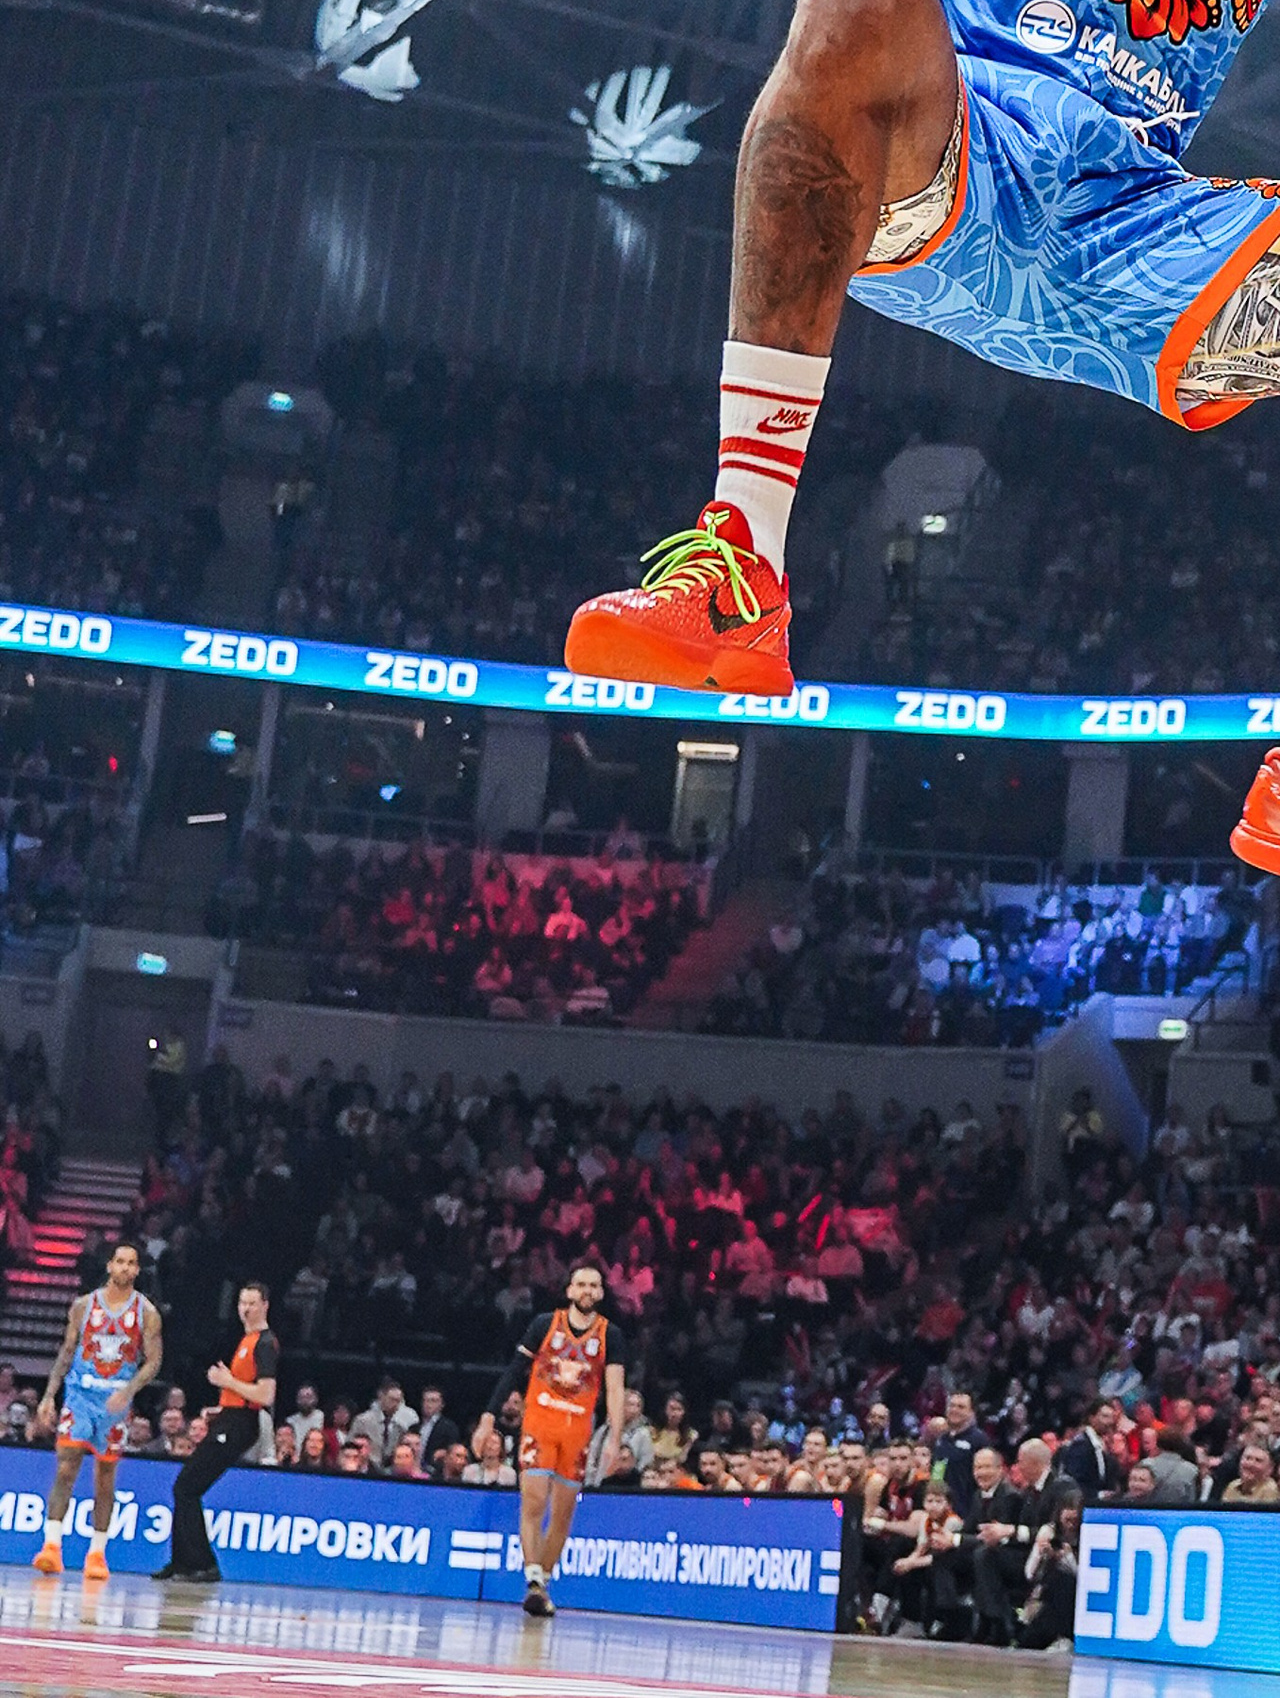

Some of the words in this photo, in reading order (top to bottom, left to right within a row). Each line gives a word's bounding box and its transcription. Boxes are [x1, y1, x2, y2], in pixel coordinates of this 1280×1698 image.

[771, 407, 813, 427] NIKE
[0, 608, 111, 653] ZEDO
[181, 629, 298, 676] ZEDO
[364, 651, 479, 698] ZEDO
[544, 670, 656, 710] ZEDO
[894, 691, 1007, 732] ZEDO
[1081, 699, 1186, 735] ZEDO
[143, 1505, 430, 1566] ЭИПИРОВКИ
[561, 1531, 678, 1583] СПОРТИВНОЙ
[678, 1543, 812, 1592] ЭКИПИРОВКИ
